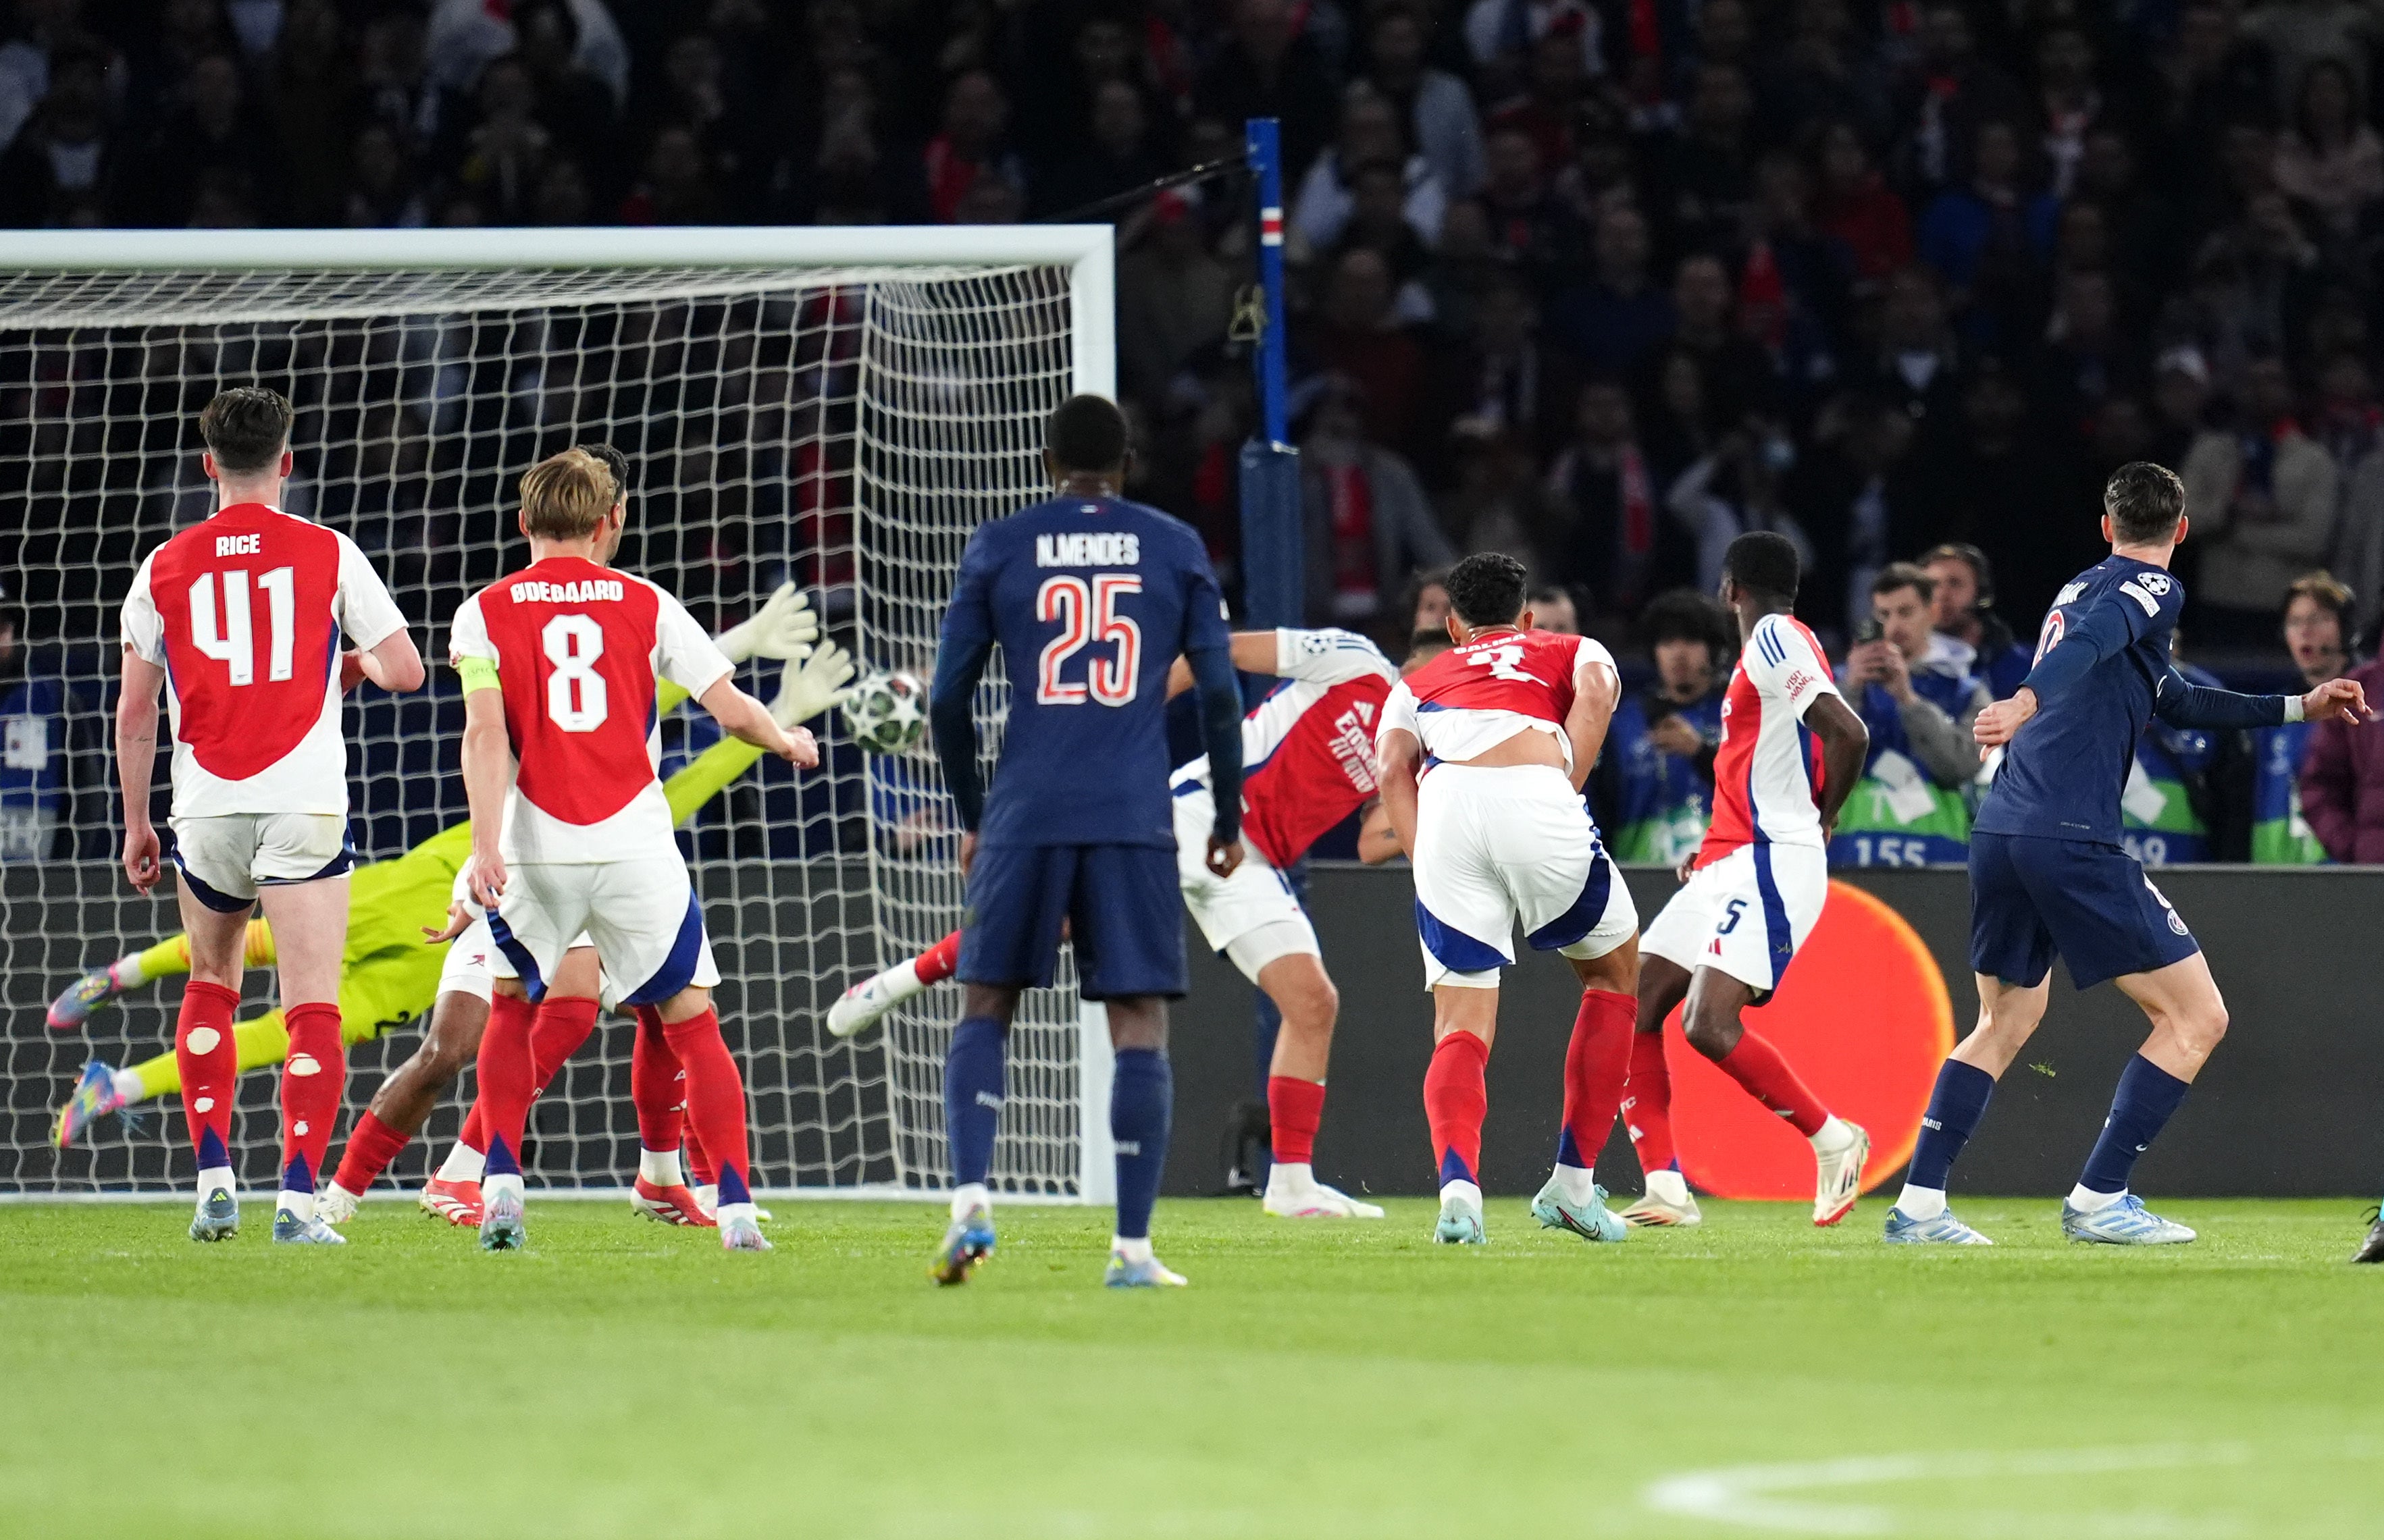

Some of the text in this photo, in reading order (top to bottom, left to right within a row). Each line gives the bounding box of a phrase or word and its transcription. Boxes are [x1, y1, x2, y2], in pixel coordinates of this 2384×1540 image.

[215, 533, 261, 557] RICE
[1037, 532, 1139, 567] N.MENDES
[510, 579, 624, 604] ØDEGAARD
[188, 566, 295, 687] 41
[1037, 573, 1142, 707] 25
[542, 613, 608, 733] 8
[1785, 670, 1802, 689] VISIT
[1857, 837, 1925, 868] 155
[1716, 899, 1748, 934] 5
